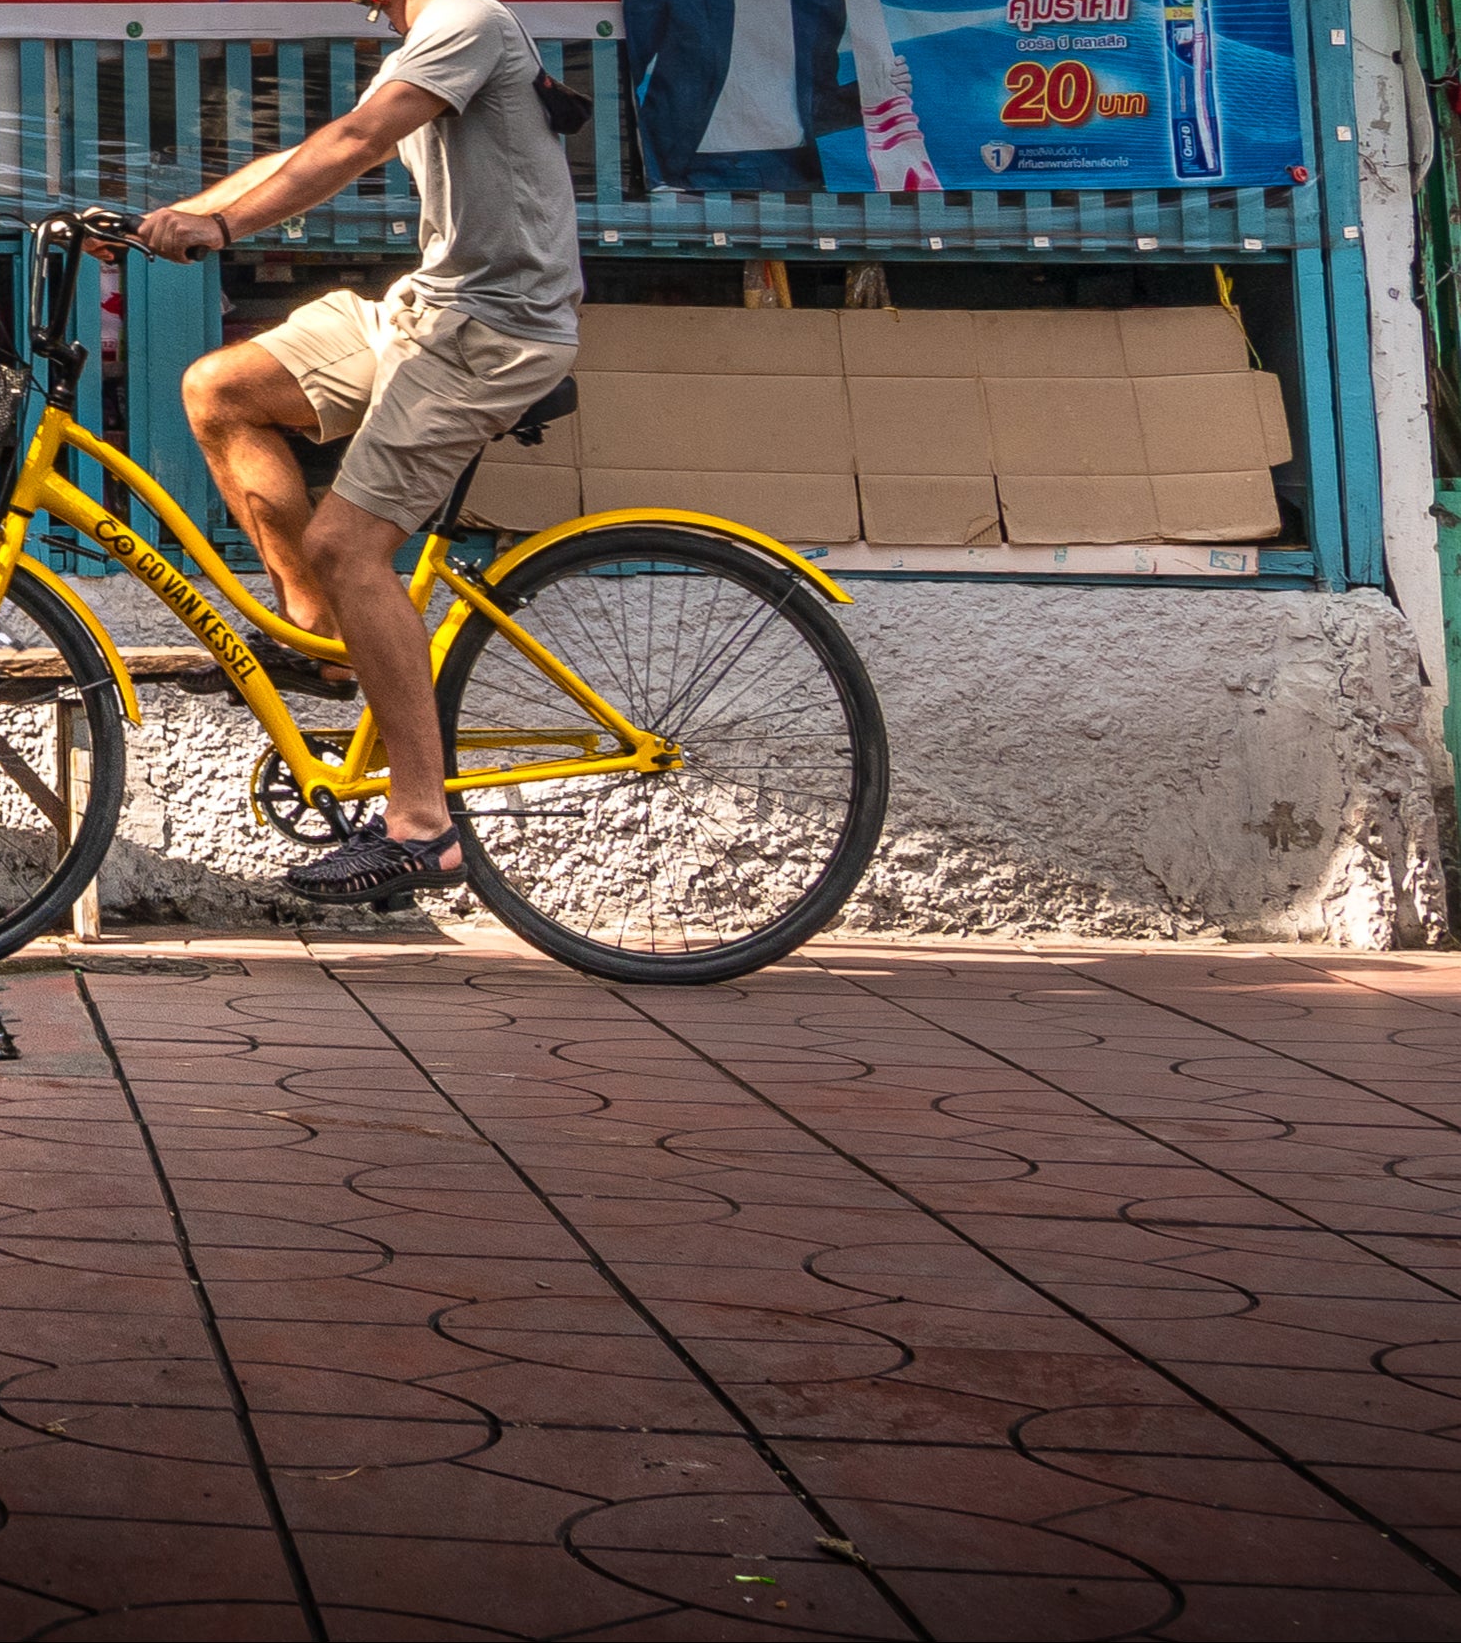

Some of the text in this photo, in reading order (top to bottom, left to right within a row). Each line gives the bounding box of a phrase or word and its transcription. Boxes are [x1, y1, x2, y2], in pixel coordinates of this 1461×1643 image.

[1000, 60, 1093, 123] 20
[1096, 93, 1147, 116] บาท
[991, 148, 1001, 168] 1
[136, 552, 257, 685] CO VAN KESSEL
